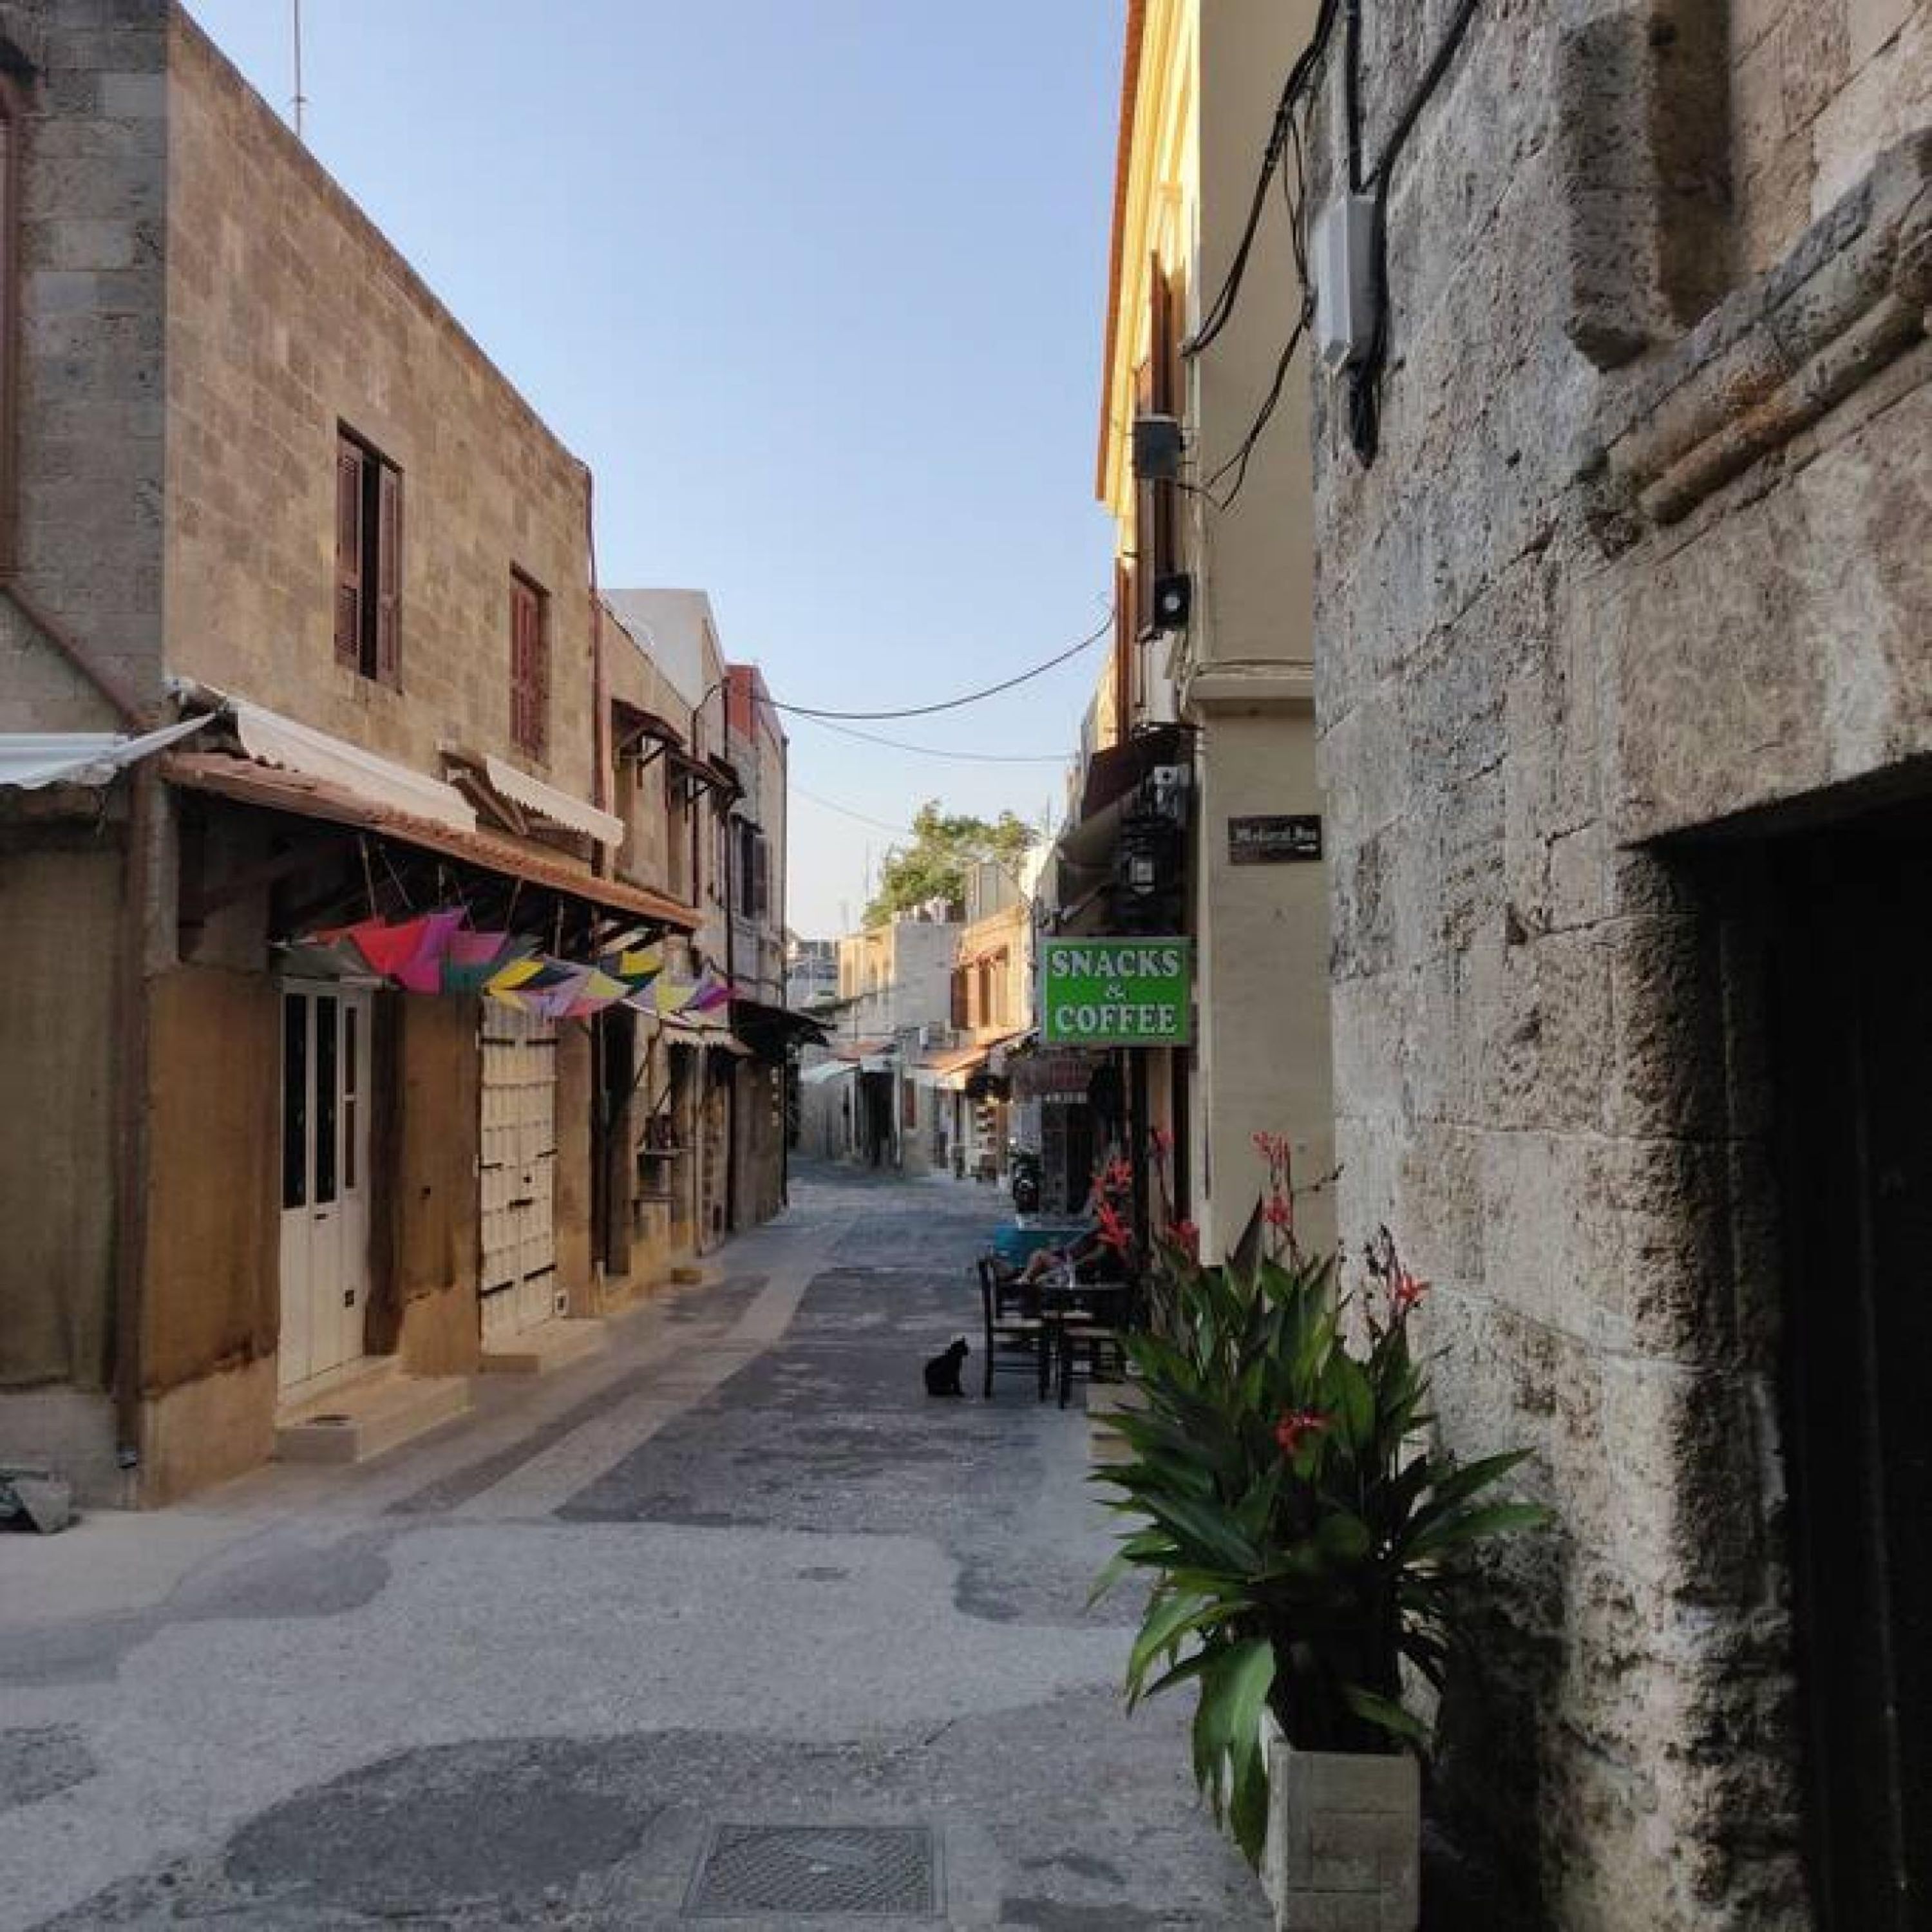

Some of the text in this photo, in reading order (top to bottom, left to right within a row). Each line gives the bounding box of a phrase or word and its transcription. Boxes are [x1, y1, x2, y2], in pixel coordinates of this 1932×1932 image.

[1052, 950, 1179, 977] SNACKS
[1105, 984, 1125, 998] &
[1054, 1005, 1177, 1033] COFFEE
